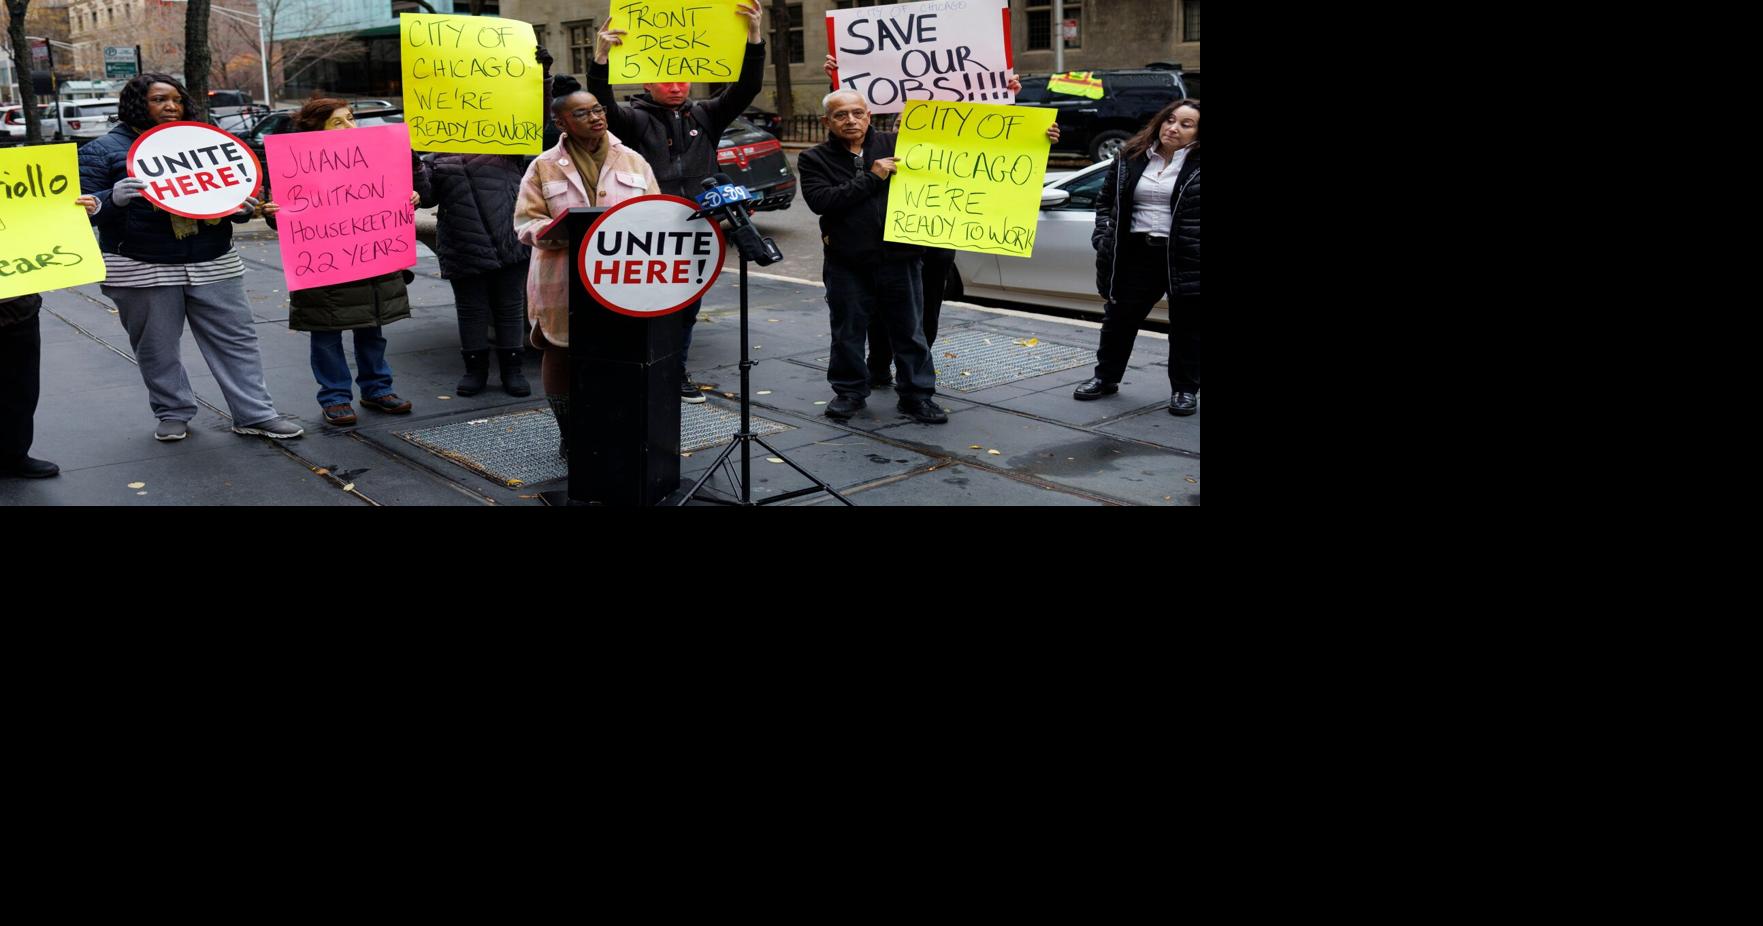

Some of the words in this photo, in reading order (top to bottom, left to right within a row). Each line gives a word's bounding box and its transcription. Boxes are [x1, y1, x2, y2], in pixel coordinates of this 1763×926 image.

[619, 1, 713, 30] FRONT
[409, 20, 465, 48] CITY
[477, 27, 513, 48] OF
[636, 30, 710, 52] DESK
[840, 14, 937, 55] SAVE
[413, 56, 526, 80] CHICAGO
[620, 54, 641, 78] 5
[647, 54, 732, 77] YEARS
[901, 46, 990, 78] OUR
[414, 87, 493, 110] WE'RE
[410, 115, 469, 139] READY
[472, 119, 496, 138] TO
[497, 114, 543, 141] WORK
[905, 104, 974, 137] CITY
[976, 113, 1025, 140] OF
[137, 142, 243, 177] UNITE
[282, 145, 369, 178] JUANA
[905, 144, 1033, 185] CHICAGO
[150, 163, 253, 201] HERE!
[287, 175, 385, 213] BUITRON
[904, 180, 987, 215] WE'RE
[290, 203, 415, 244] HOUSEKEEPING
[893, 210, 956, 240] READY
[961, 222, 984, 241] TO
[988, 217, 1034, 251] WORK
[295, 251, 339, 277] 22
[342, 235, 409, 266] YEARS
[597, 231, 713, 256] UNITE
[593, 259, 707, 285] HERE!
